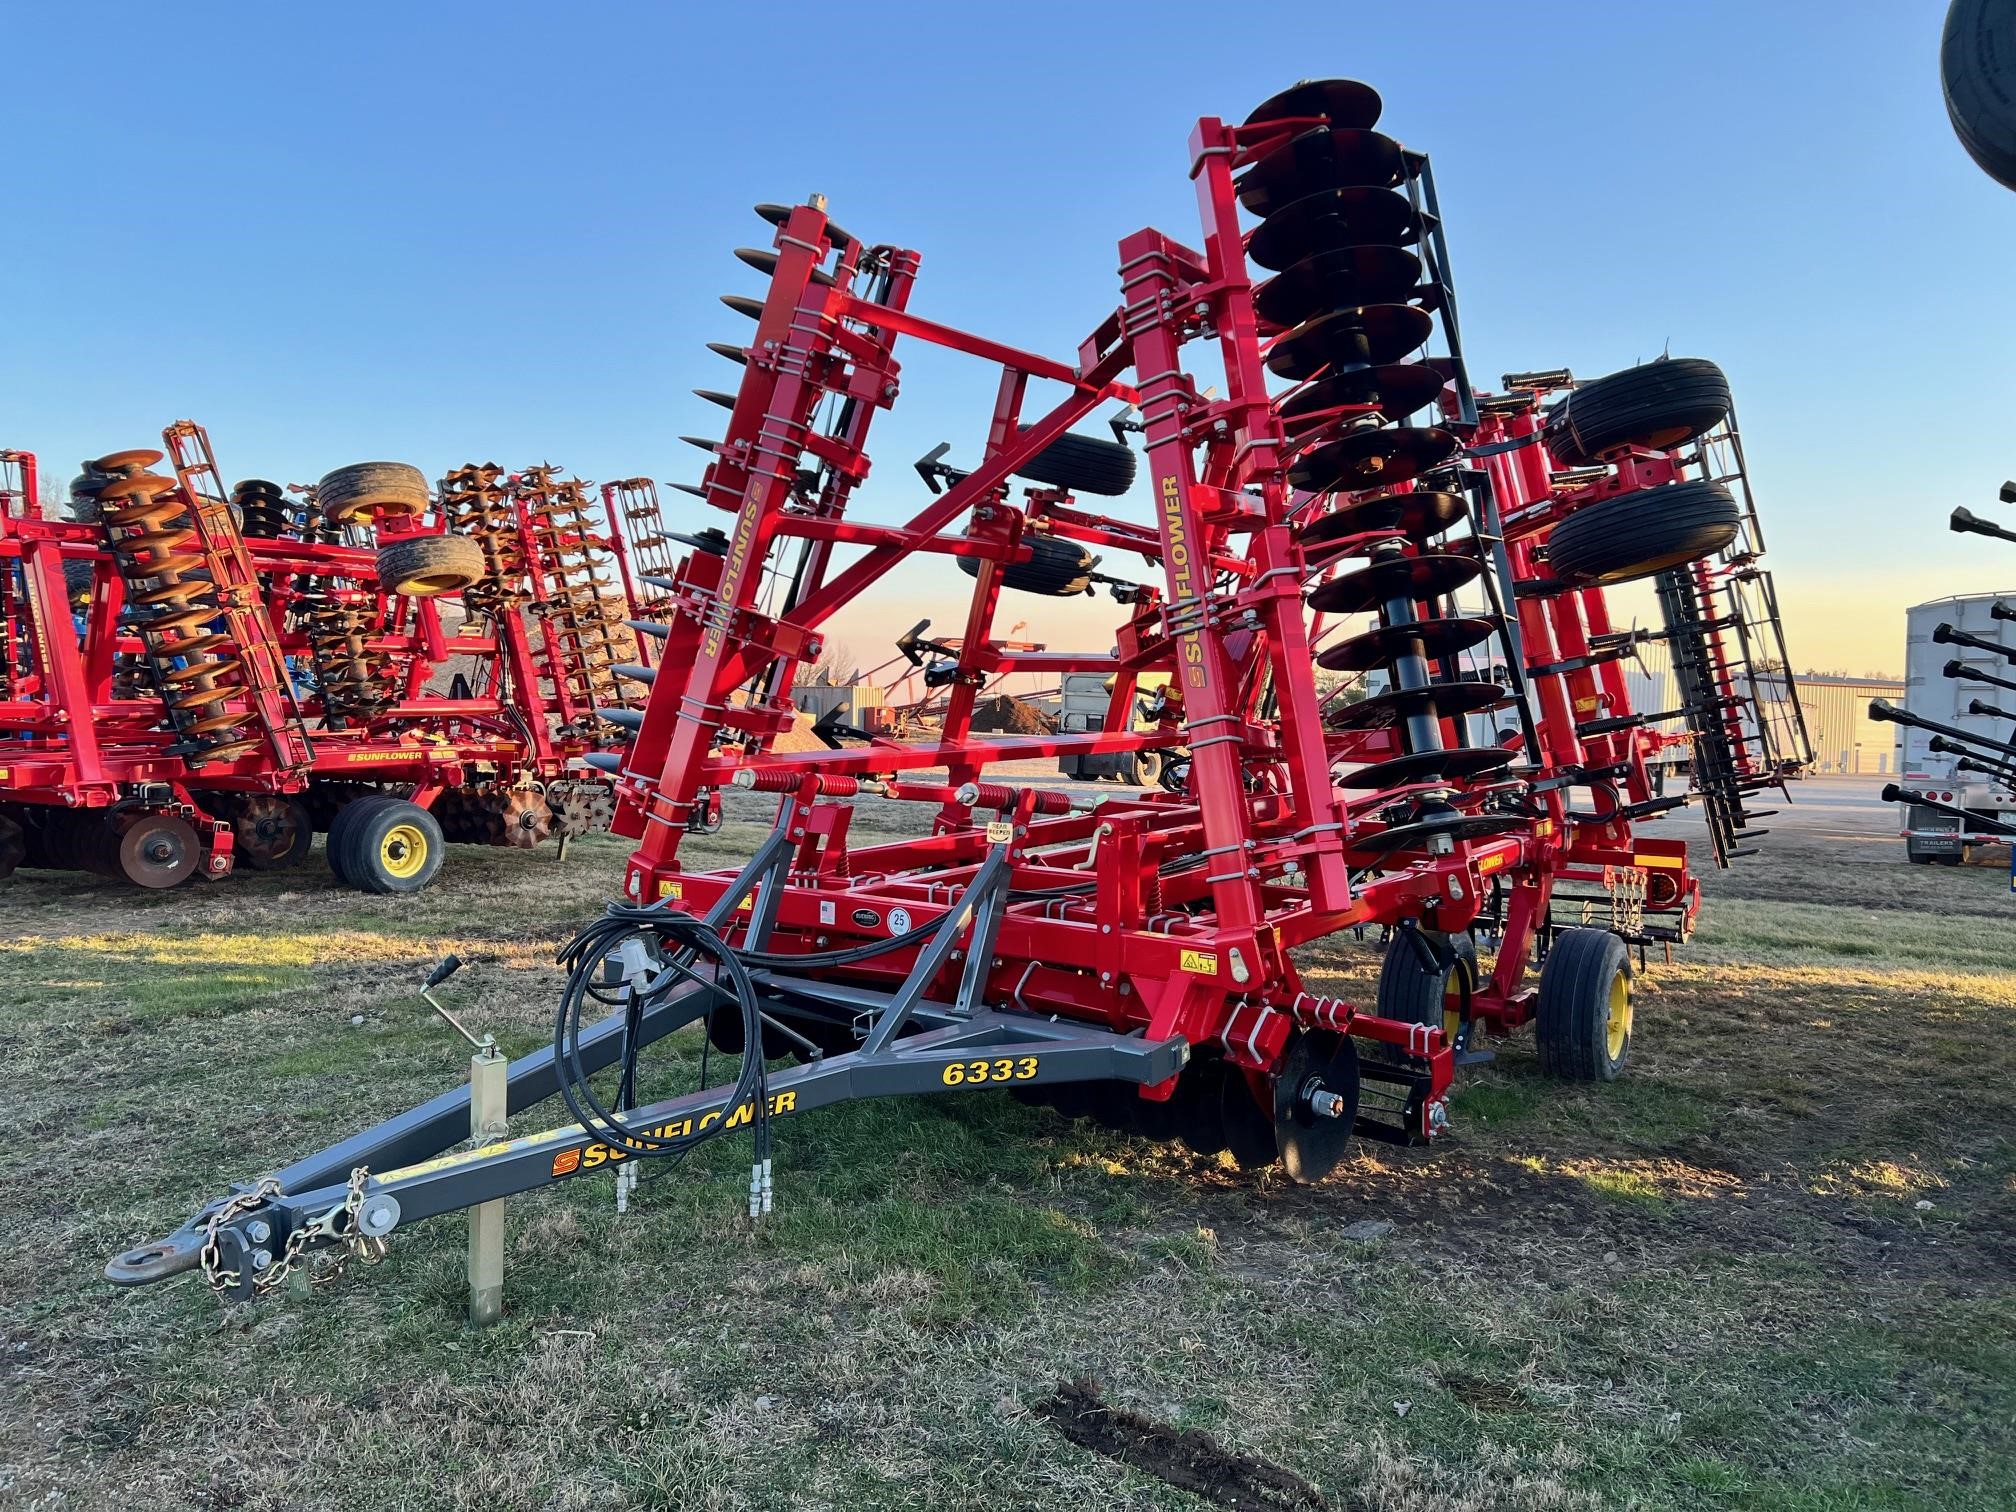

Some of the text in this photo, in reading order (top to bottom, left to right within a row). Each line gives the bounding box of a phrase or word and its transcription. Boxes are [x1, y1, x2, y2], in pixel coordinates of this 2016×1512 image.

[356, 751, 422, 762] SUNFLOWER
[893, 913, 905, 927] 25
[942, 1056, 1039, 1086] 6333
